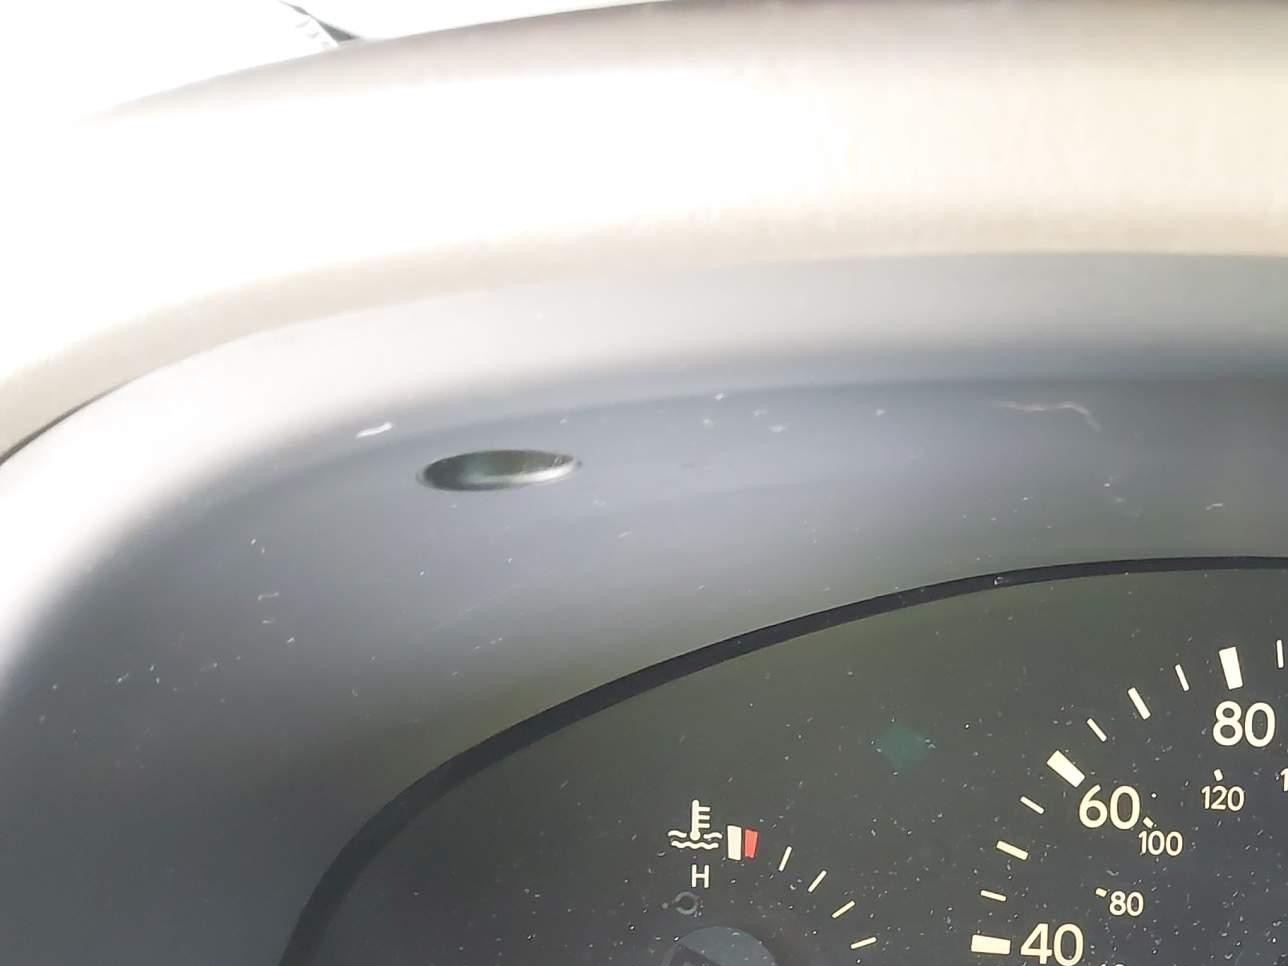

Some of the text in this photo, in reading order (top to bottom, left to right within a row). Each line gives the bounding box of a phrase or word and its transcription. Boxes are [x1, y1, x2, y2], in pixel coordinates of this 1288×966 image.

[1213, 701, 1276, 747] 80
[1078, 785, 1141, 831] 60
[1201, 786, 1245, 811] 120
[1138, 830, 1183, 856] 100
[692, 865, 709, 888] H
[1109, 891, 1143, 916] 80
[1020, 924, 1084, 966] 40
